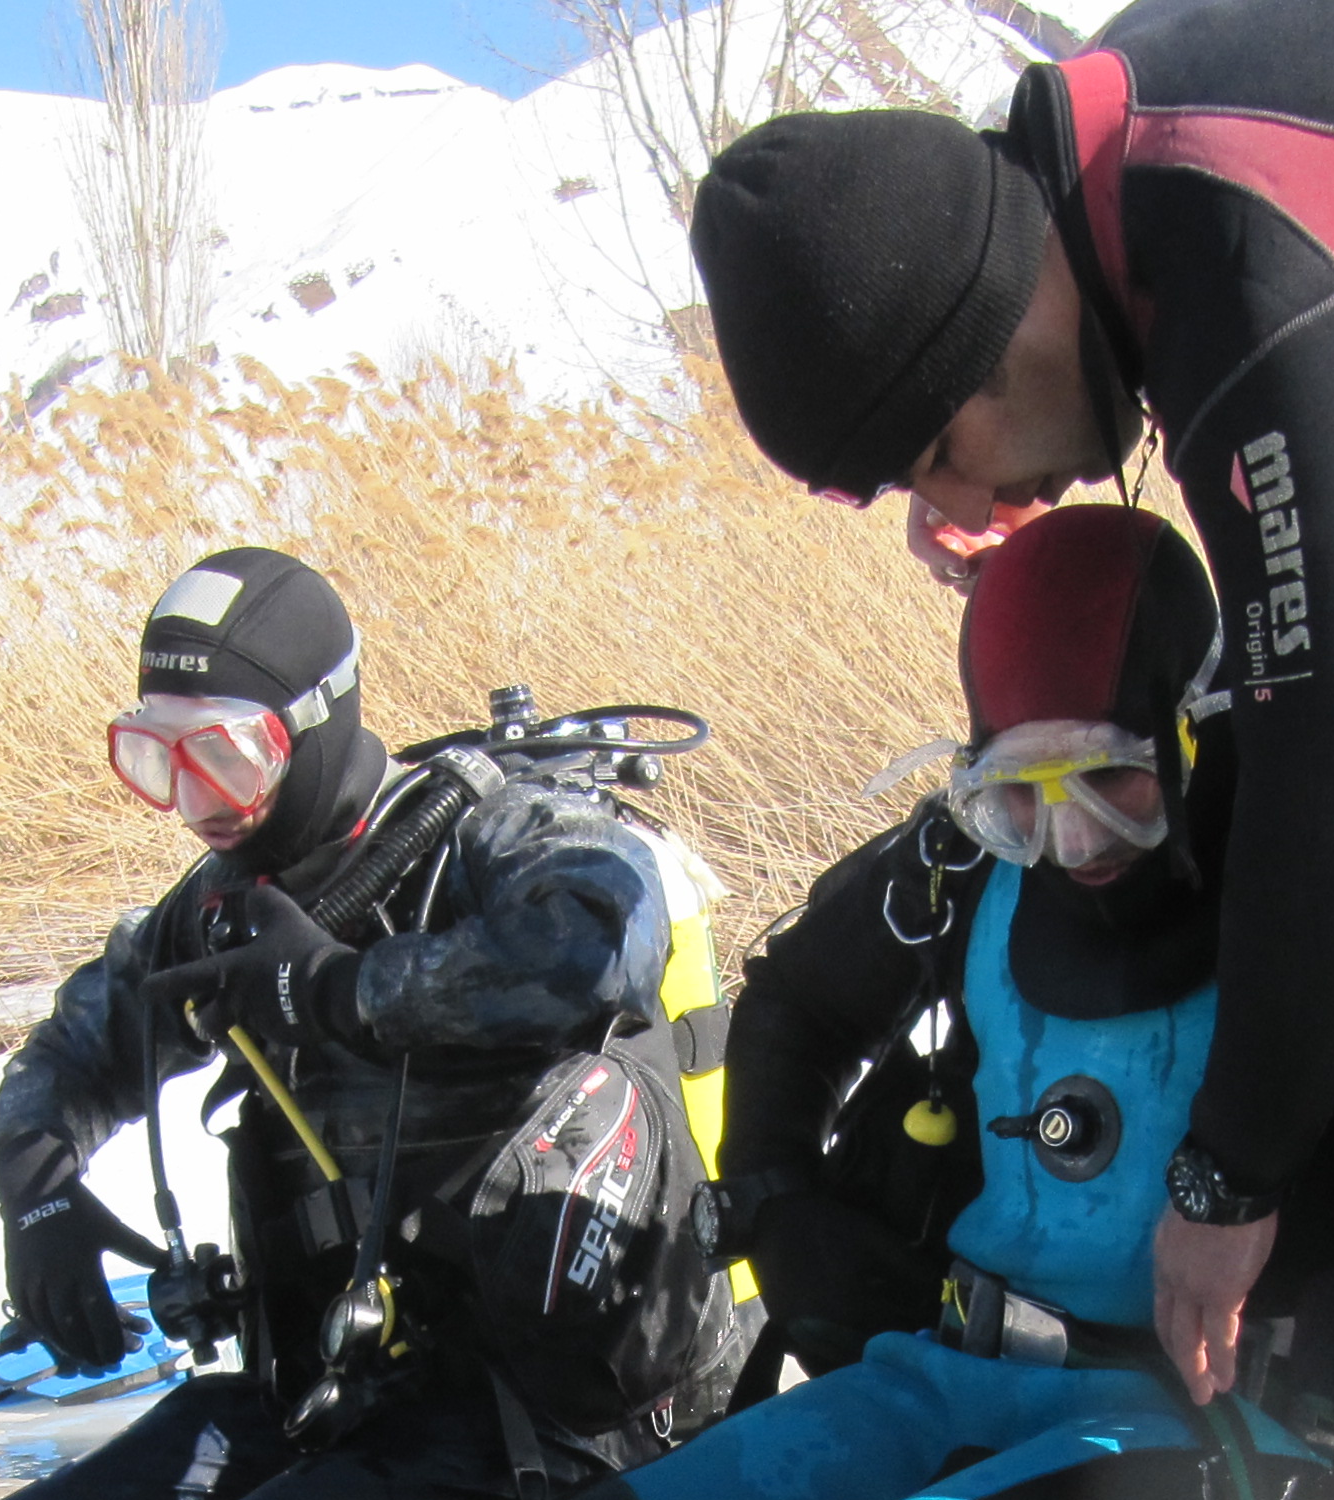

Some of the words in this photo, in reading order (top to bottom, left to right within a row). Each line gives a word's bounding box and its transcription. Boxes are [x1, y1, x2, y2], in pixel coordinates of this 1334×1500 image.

[1243, 430, 1312, 656] mares
[141, 651, 209, 673] mares
[1246, 602, 1268, 677] Origin
[1254, 688, 1272, 702] 5
[549, 1105, 577, 1138] BACK
[568, 1160, 635, 1291] seac
